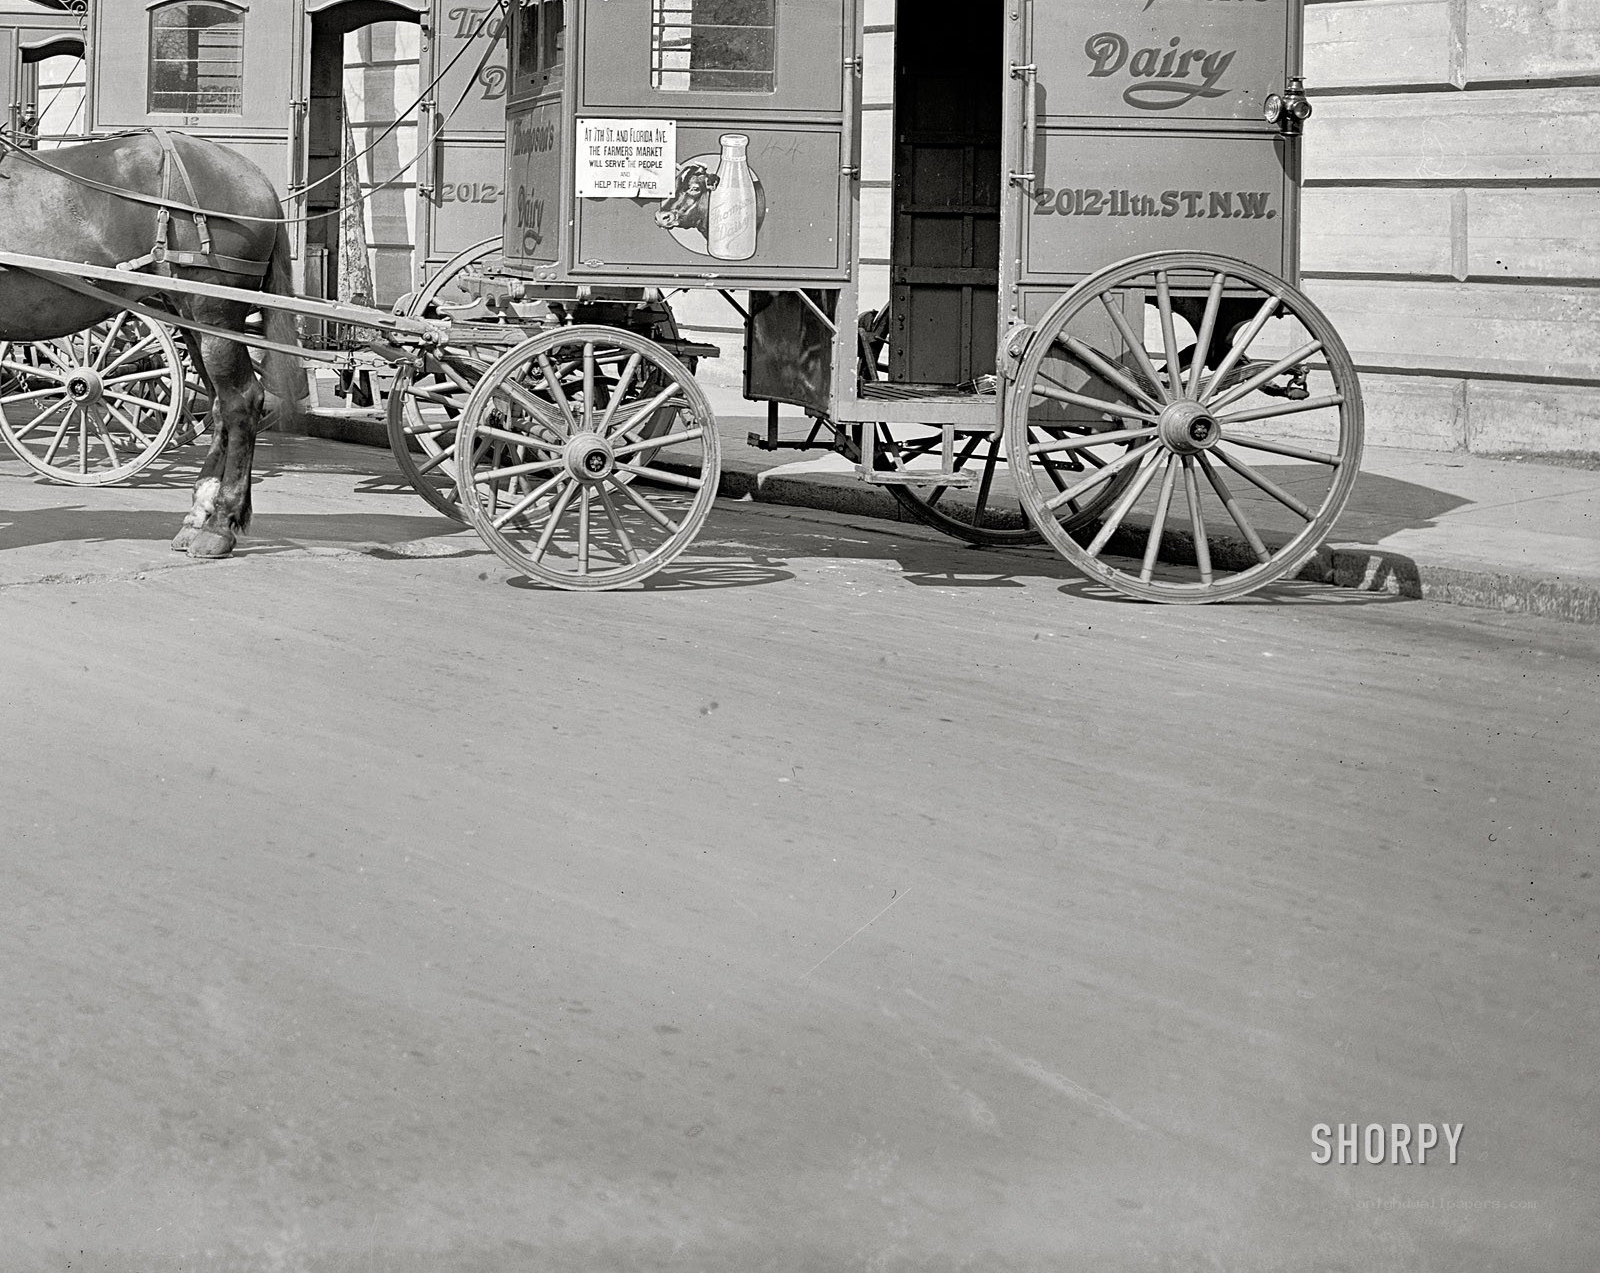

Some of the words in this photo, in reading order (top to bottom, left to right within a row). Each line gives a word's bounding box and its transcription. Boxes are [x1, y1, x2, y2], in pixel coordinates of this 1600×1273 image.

[1085, 32, 1237, 111] Dairy
[183, 116, 200, 126] 12
[584, 127, 592, 142] AT
[594, 127, 605, 142] 7TH
[606, 127, 615, 142] ST.
[616, 129, 629, 143] AND
[629, 127, 653, 143] FLORIDA
[589, 145, 601, 156] THE
[603, 146, 633, 156] FARMERS
[636, 146, 663, 157] MARKET
[589, 159, 603, 168] WILL
[605, 159, 626, 168] SERVE
[627, 160, 636, 168] THE
[638, 160, 663, 169] PEOPLE
[594, 180, 612, 189] HELP
[613, 181, 626, 189] THE
[628, 181, 657, 190] FARMER
[517, 185, 544, 256] Dairy
